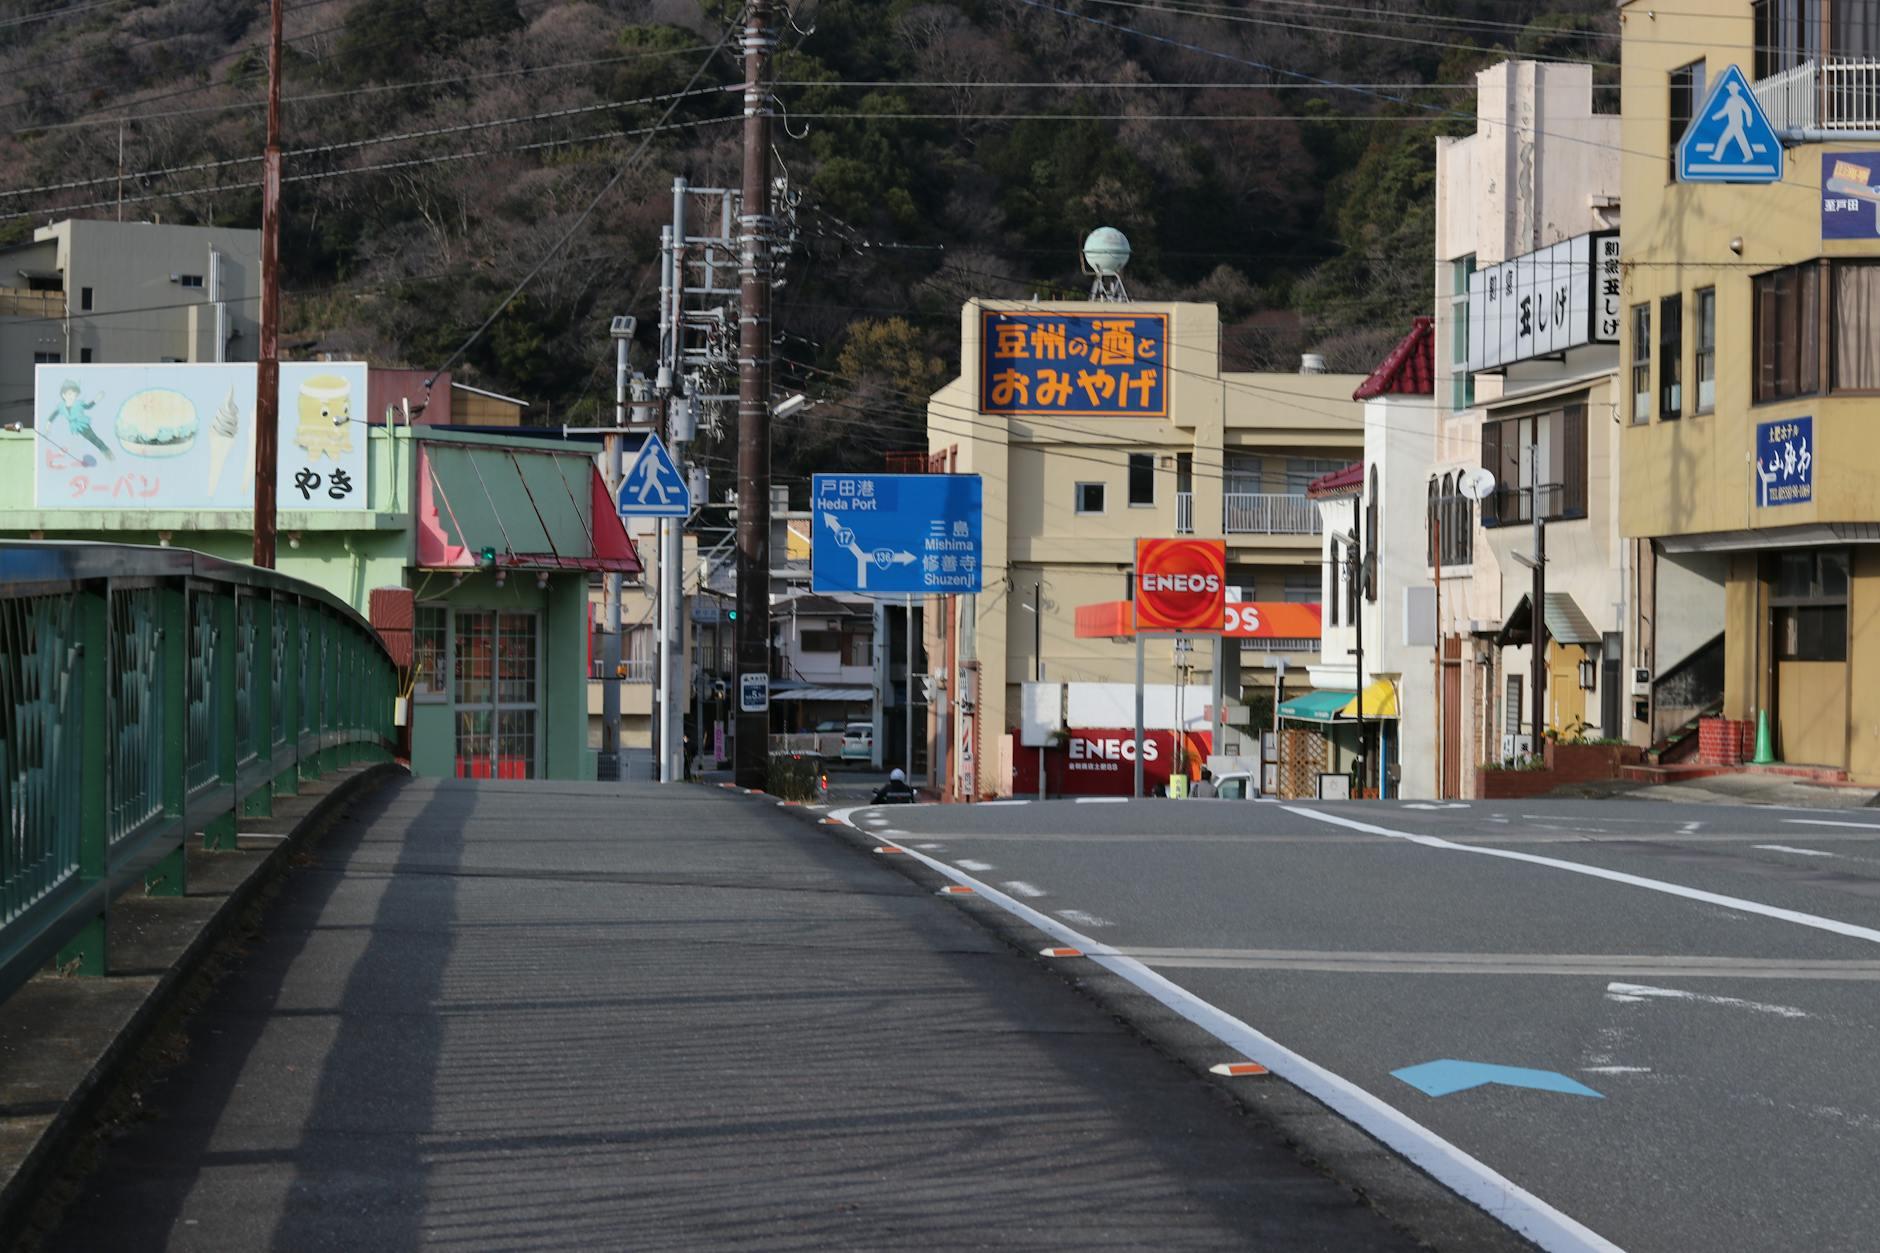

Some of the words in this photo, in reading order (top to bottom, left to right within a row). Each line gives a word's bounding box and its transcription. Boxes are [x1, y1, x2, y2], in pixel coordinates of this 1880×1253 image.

[994, 320, 1157, 366] 豆州の酒と
[992, 367, 1158, 408] おみやげ
[294, 467, 353, 501] やき
[820, 479, 875, 497] 戸田港
[817, 498, 848, 510] Heda
[852, 498, 877, 510] Port
[839, 531, 850, 544] 17
[930, 520, 969, 537] 三島
[925, 538, 973, 551] Mishima
[922, 554, 976, 572] 修善寺
[924, 573, 975, 588] Shuzenji
[1142, 573, 1220, 593] ENEOS
[1068, 738, 1159, 762] ENEOS
